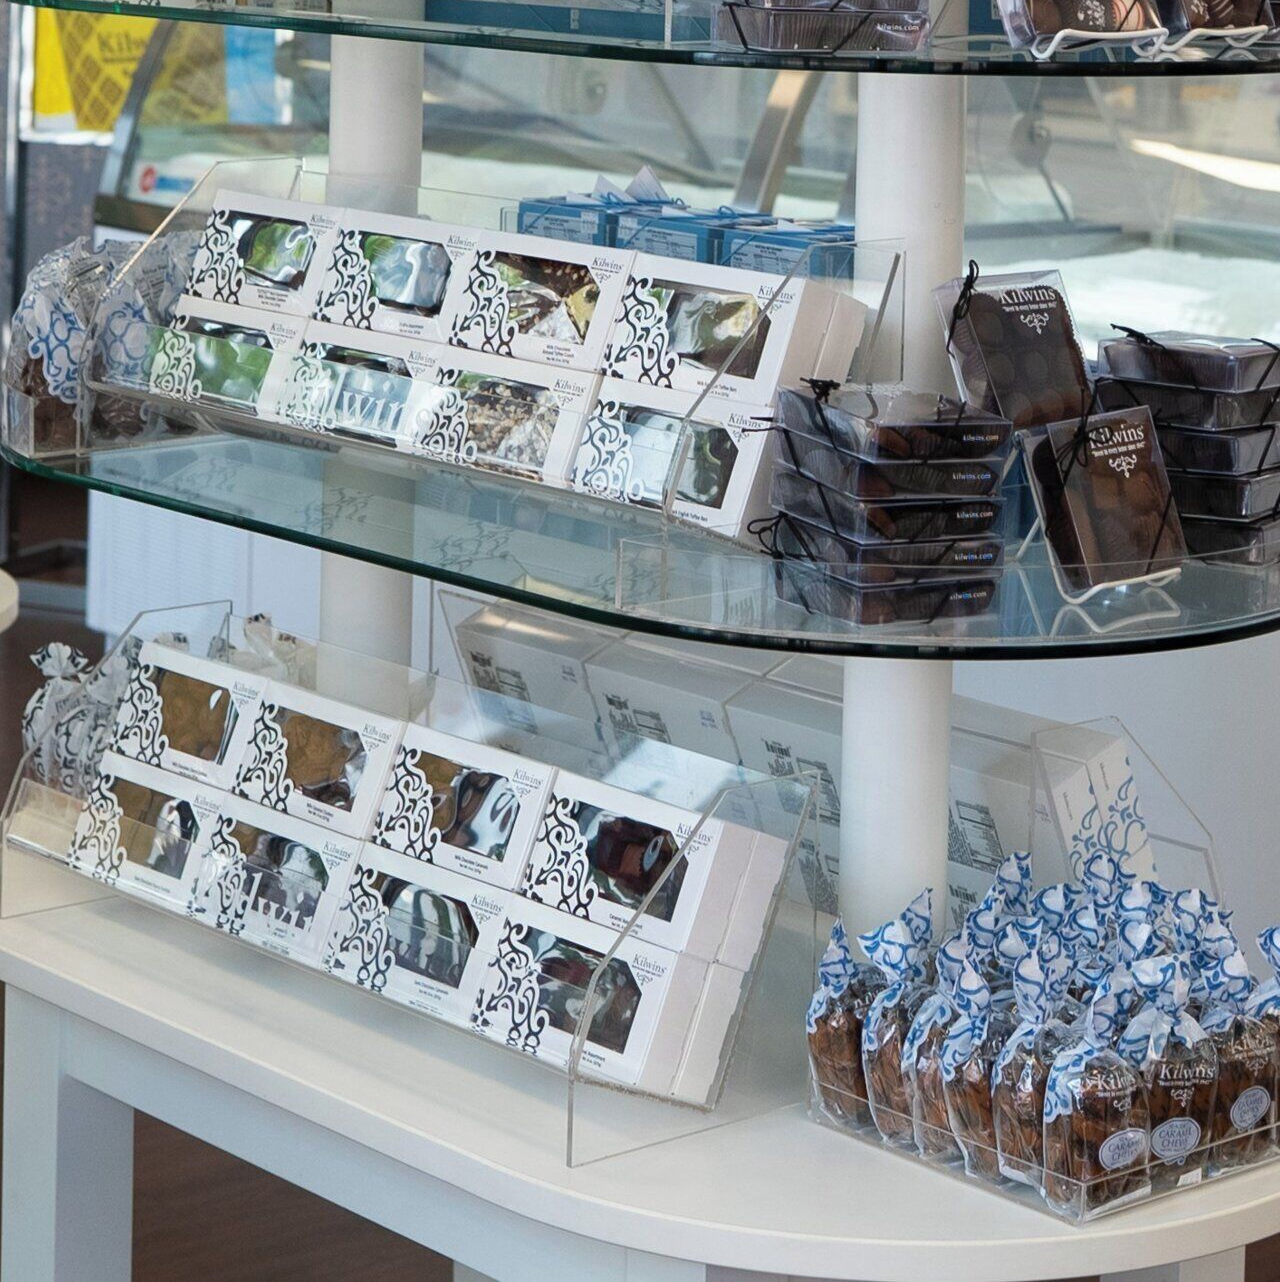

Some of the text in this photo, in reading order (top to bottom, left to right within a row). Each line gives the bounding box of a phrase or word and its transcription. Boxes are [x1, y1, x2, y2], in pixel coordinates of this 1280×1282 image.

[876, 22, 920, 32] kilwins.com
[999, 287, 1056, 306] Kilwins
[962, 432, 1000, 442] kilwins.com
[951, 472, 992, 481] kilwins.com
[956, 510, 994, 519] kilwins.com
[954, 552, 994, 561] kilwins.com
